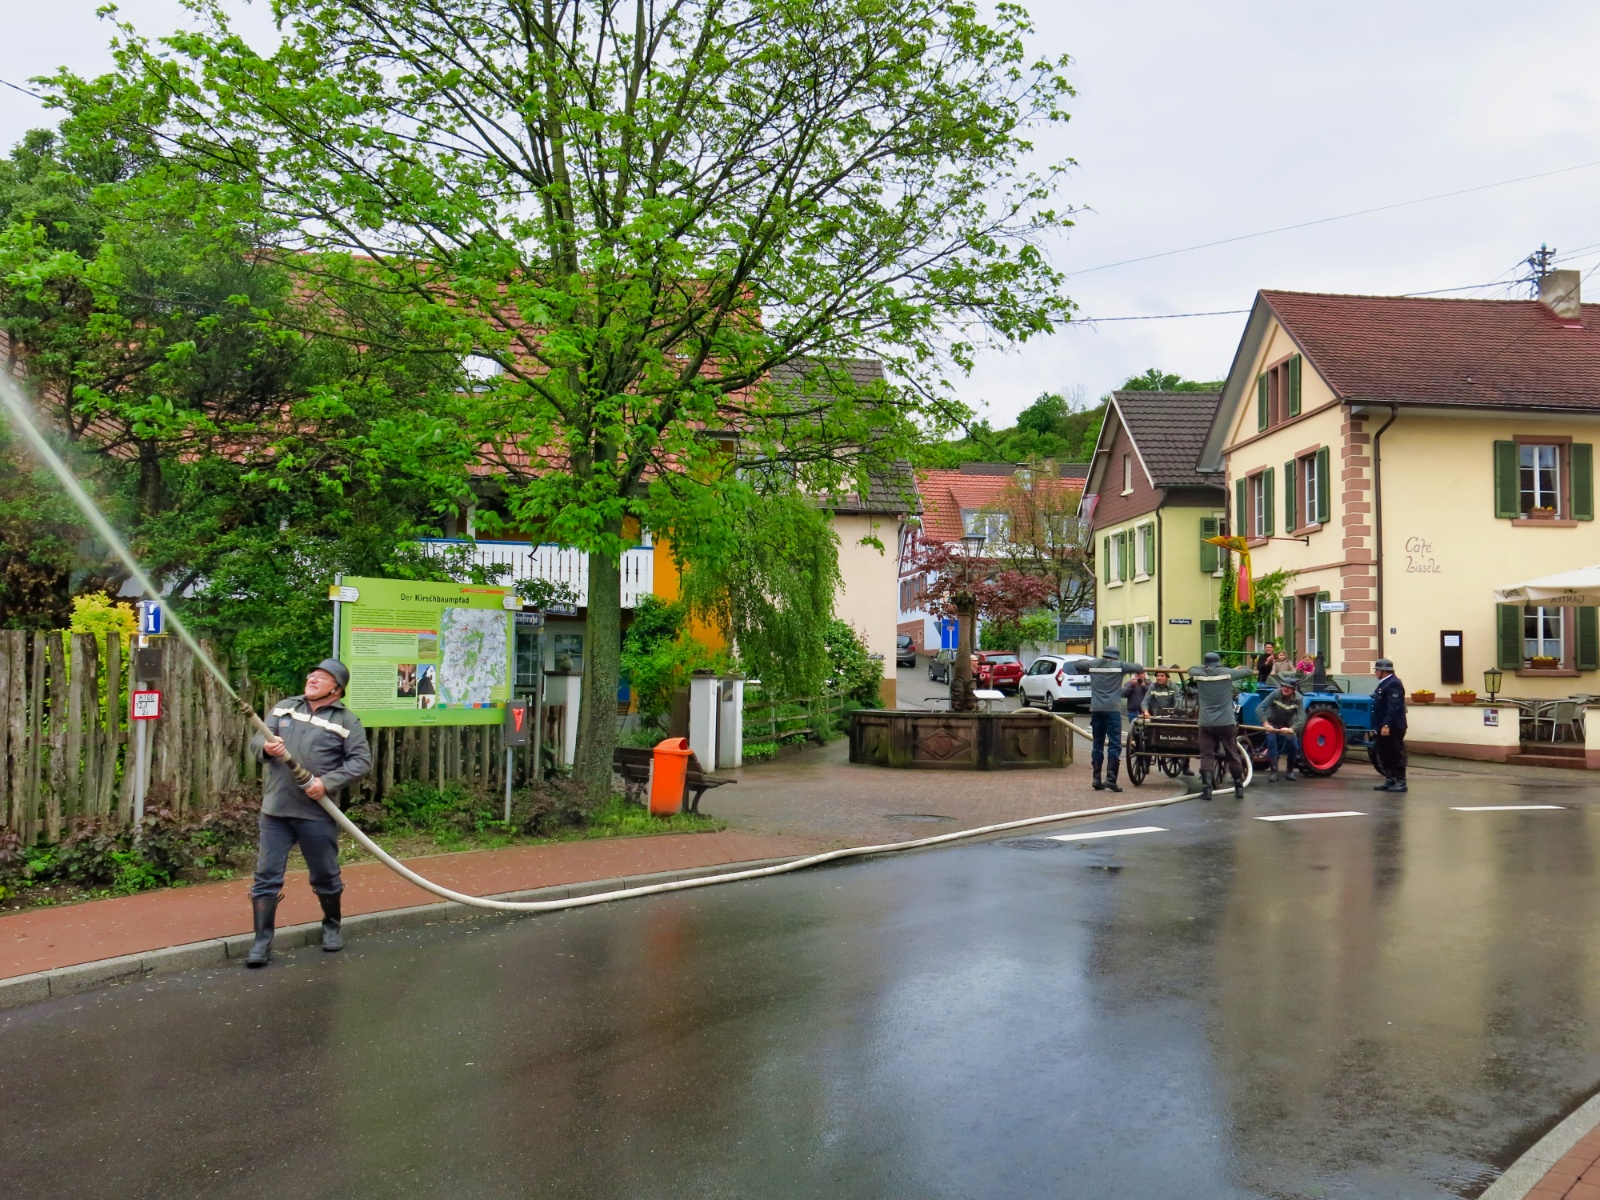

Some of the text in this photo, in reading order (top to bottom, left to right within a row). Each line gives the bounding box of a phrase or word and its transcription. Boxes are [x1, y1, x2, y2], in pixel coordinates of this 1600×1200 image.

[1405, 536, 1433, 558] Café
[400, 593, 470, 605] Der Kirschbaumpfad
